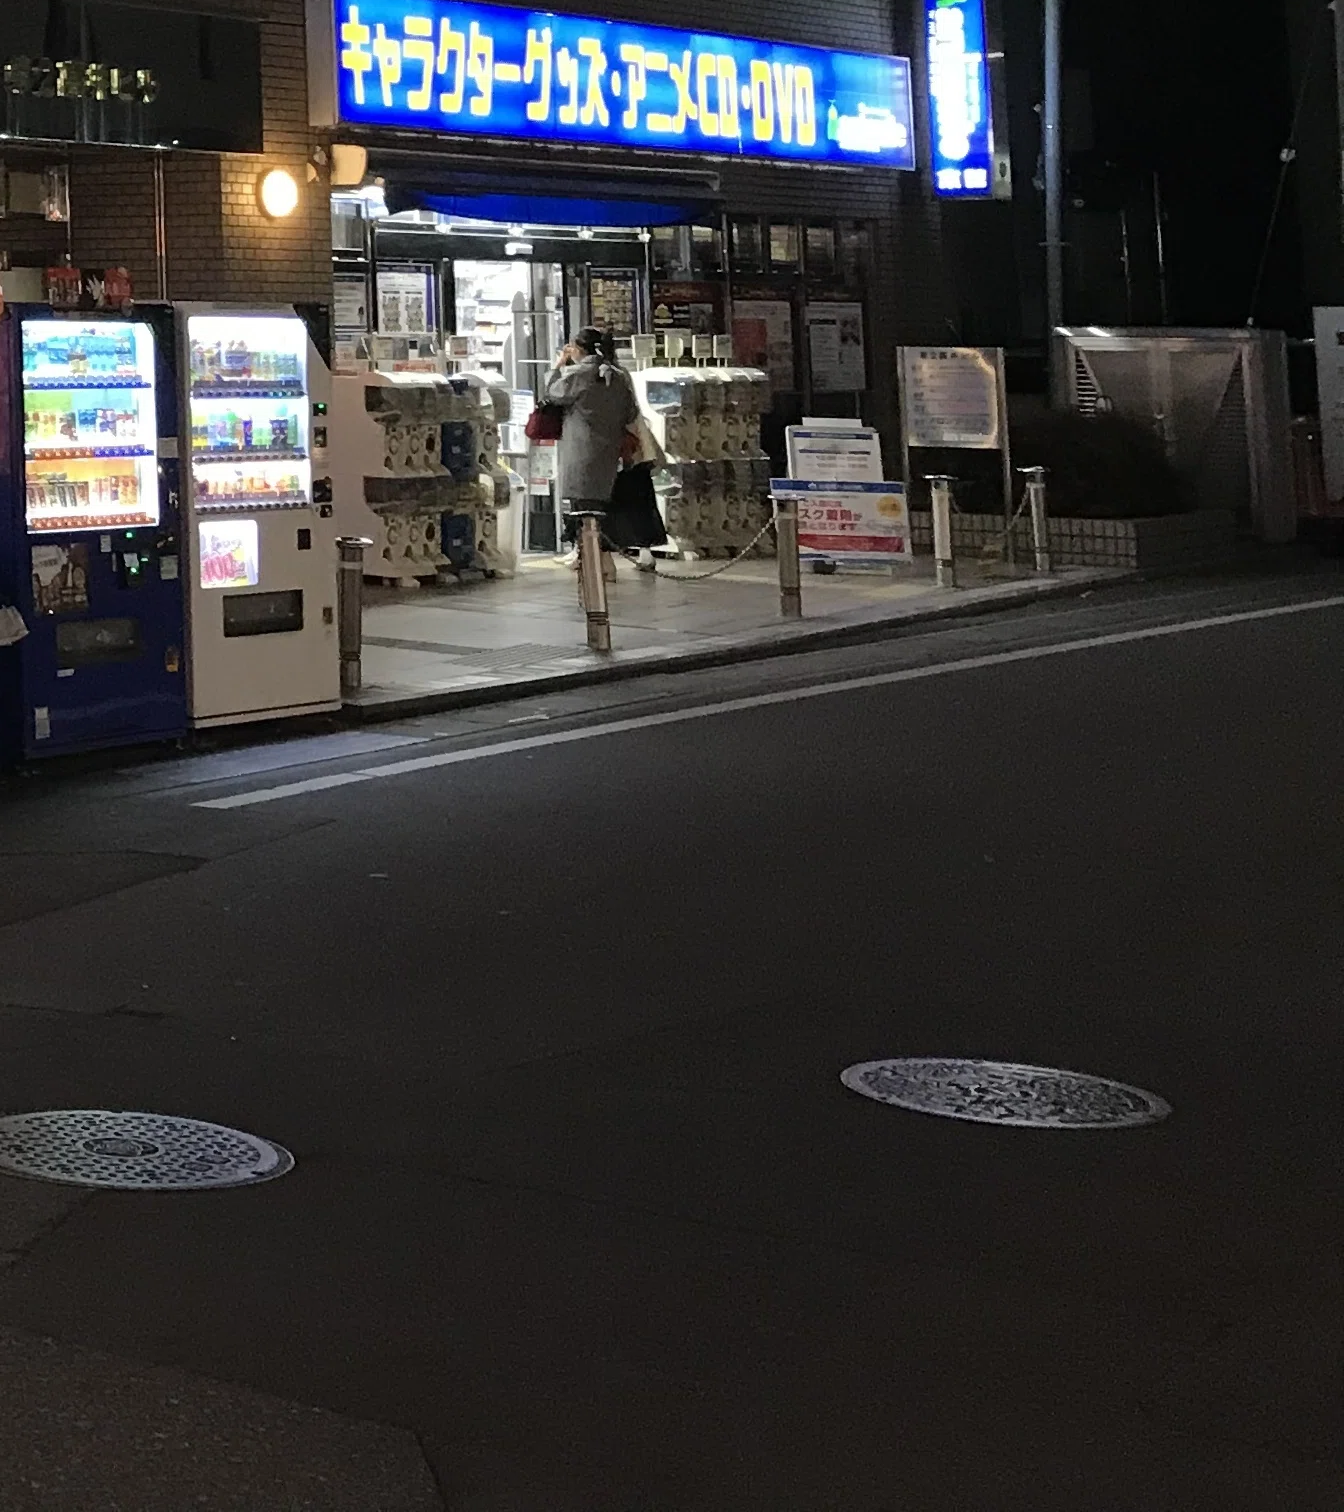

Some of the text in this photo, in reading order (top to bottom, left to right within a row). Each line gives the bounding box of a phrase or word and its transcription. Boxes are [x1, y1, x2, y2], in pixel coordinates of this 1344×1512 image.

[341, 5, 817, 148] キャラクターグッズ・アニメCD・DVD
